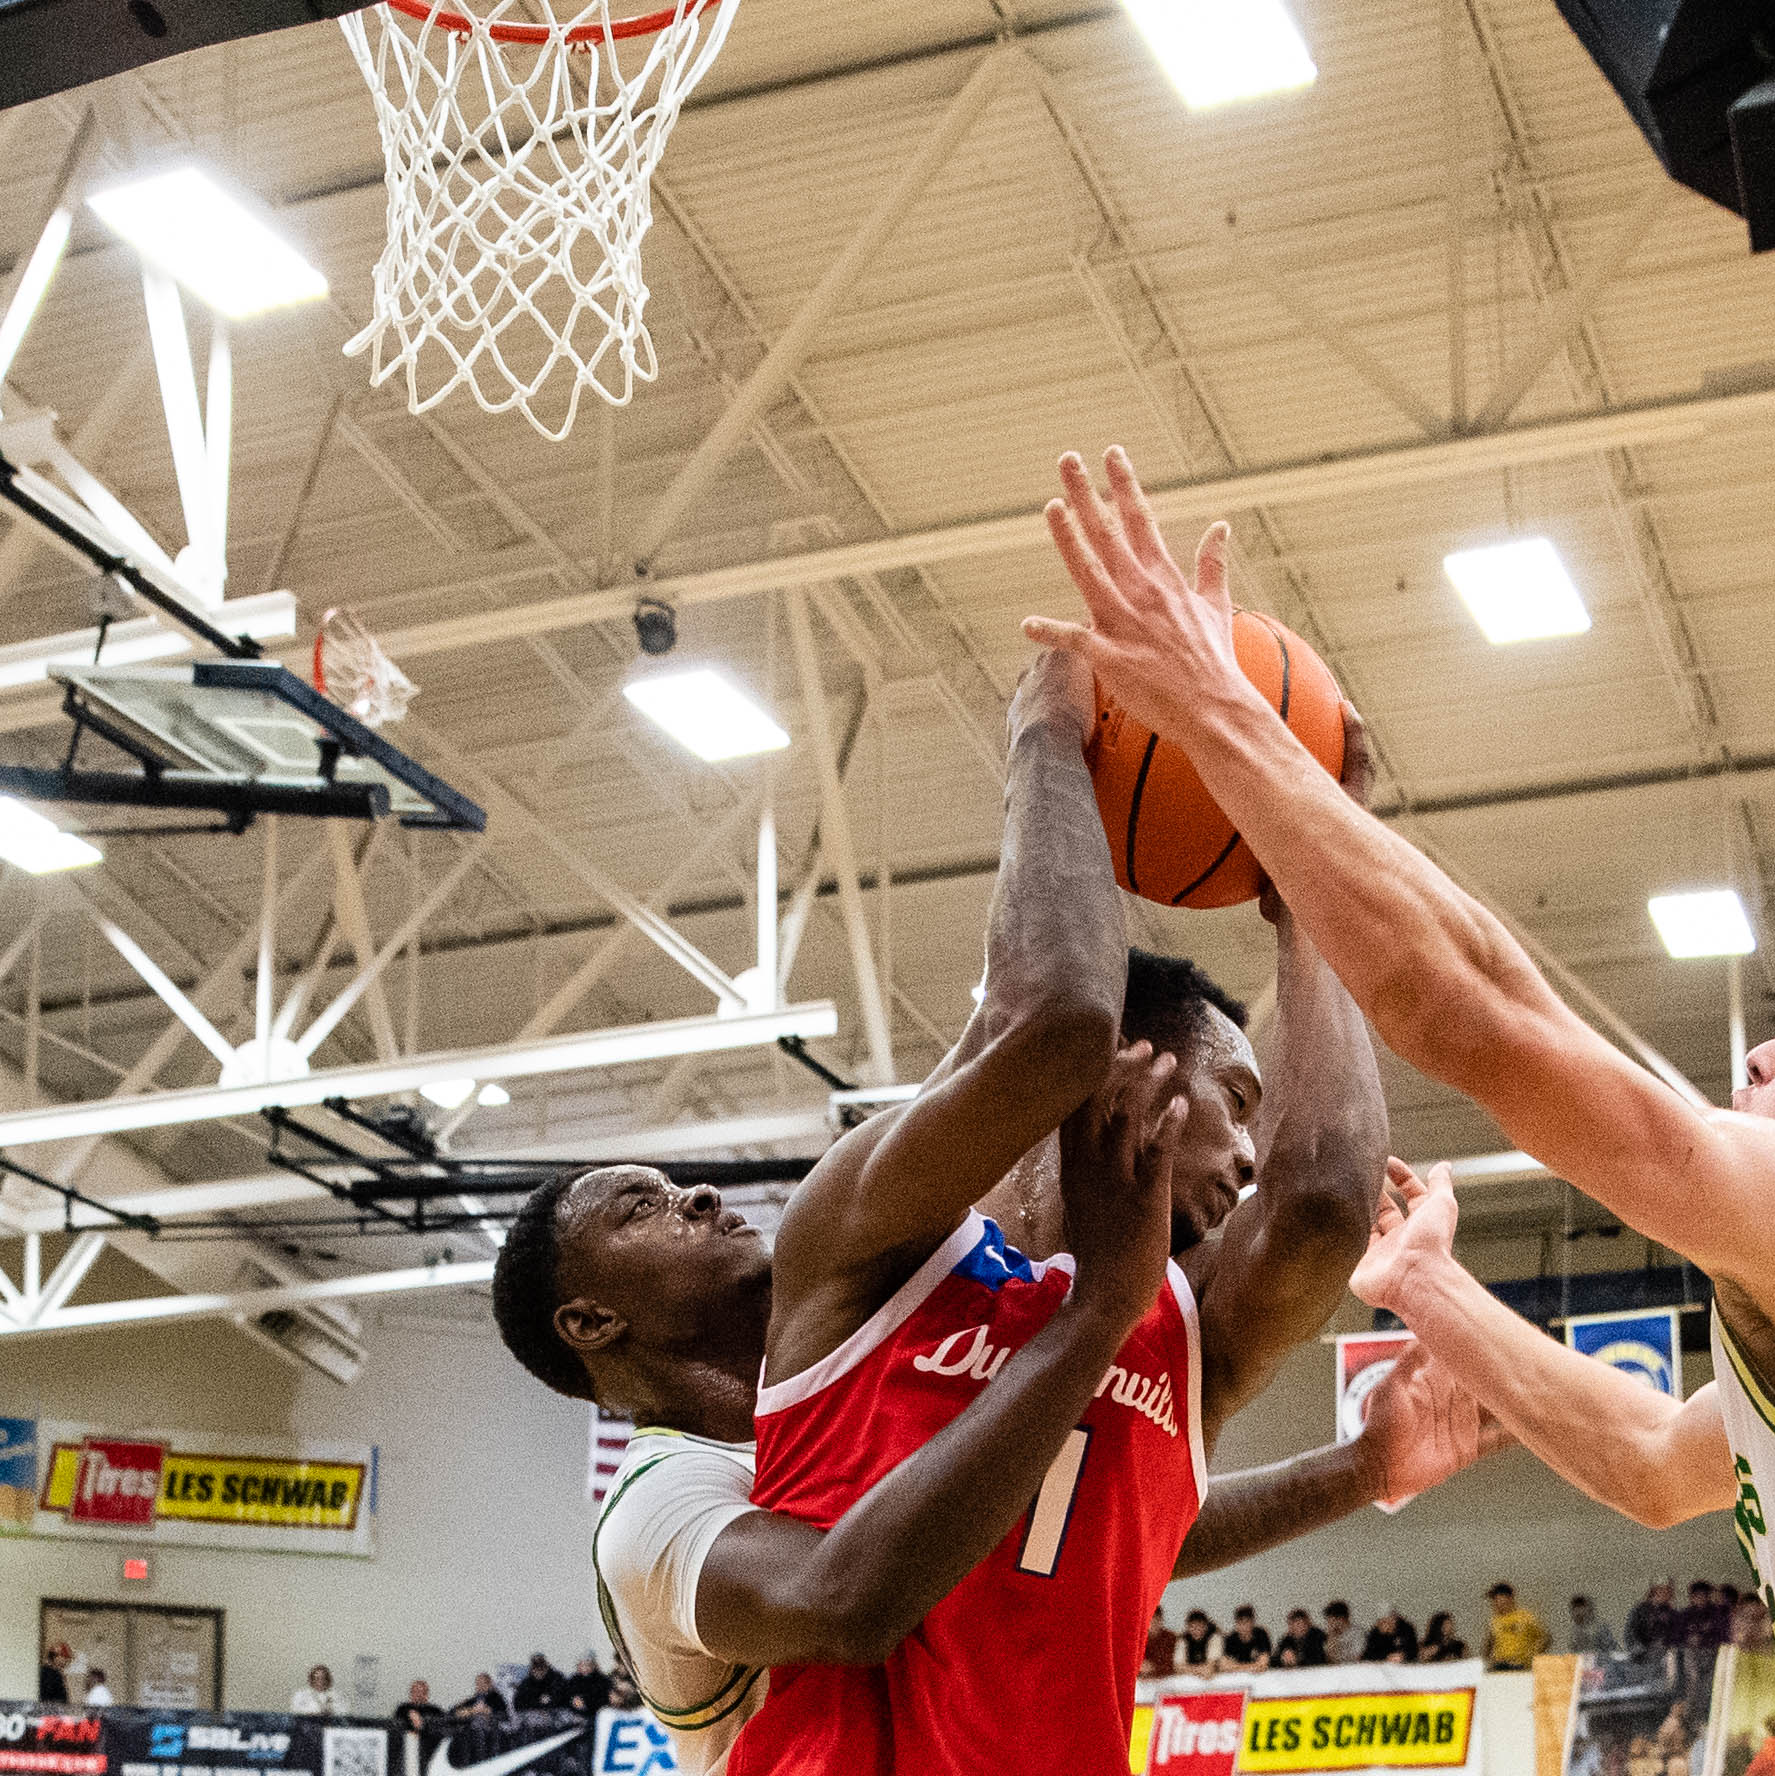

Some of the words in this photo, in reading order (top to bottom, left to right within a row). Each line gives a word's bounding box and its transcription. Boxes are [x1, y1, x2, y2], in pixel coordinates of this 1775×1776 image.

[78, 1451, 156, 1500] Tires
[165, 1471, 215, 1501] LES
[221, 1473, 350, 1510] SCHWAB
[1016, 1424, 1092, 1578] 1
[36, 1714, 102, 1742] FAN
[1154, 1705, 1240, 1765] Tires
[1249, 1717, 1301, 1752] LES
[1311, 1709, 1456, 1750] SCHWAB
